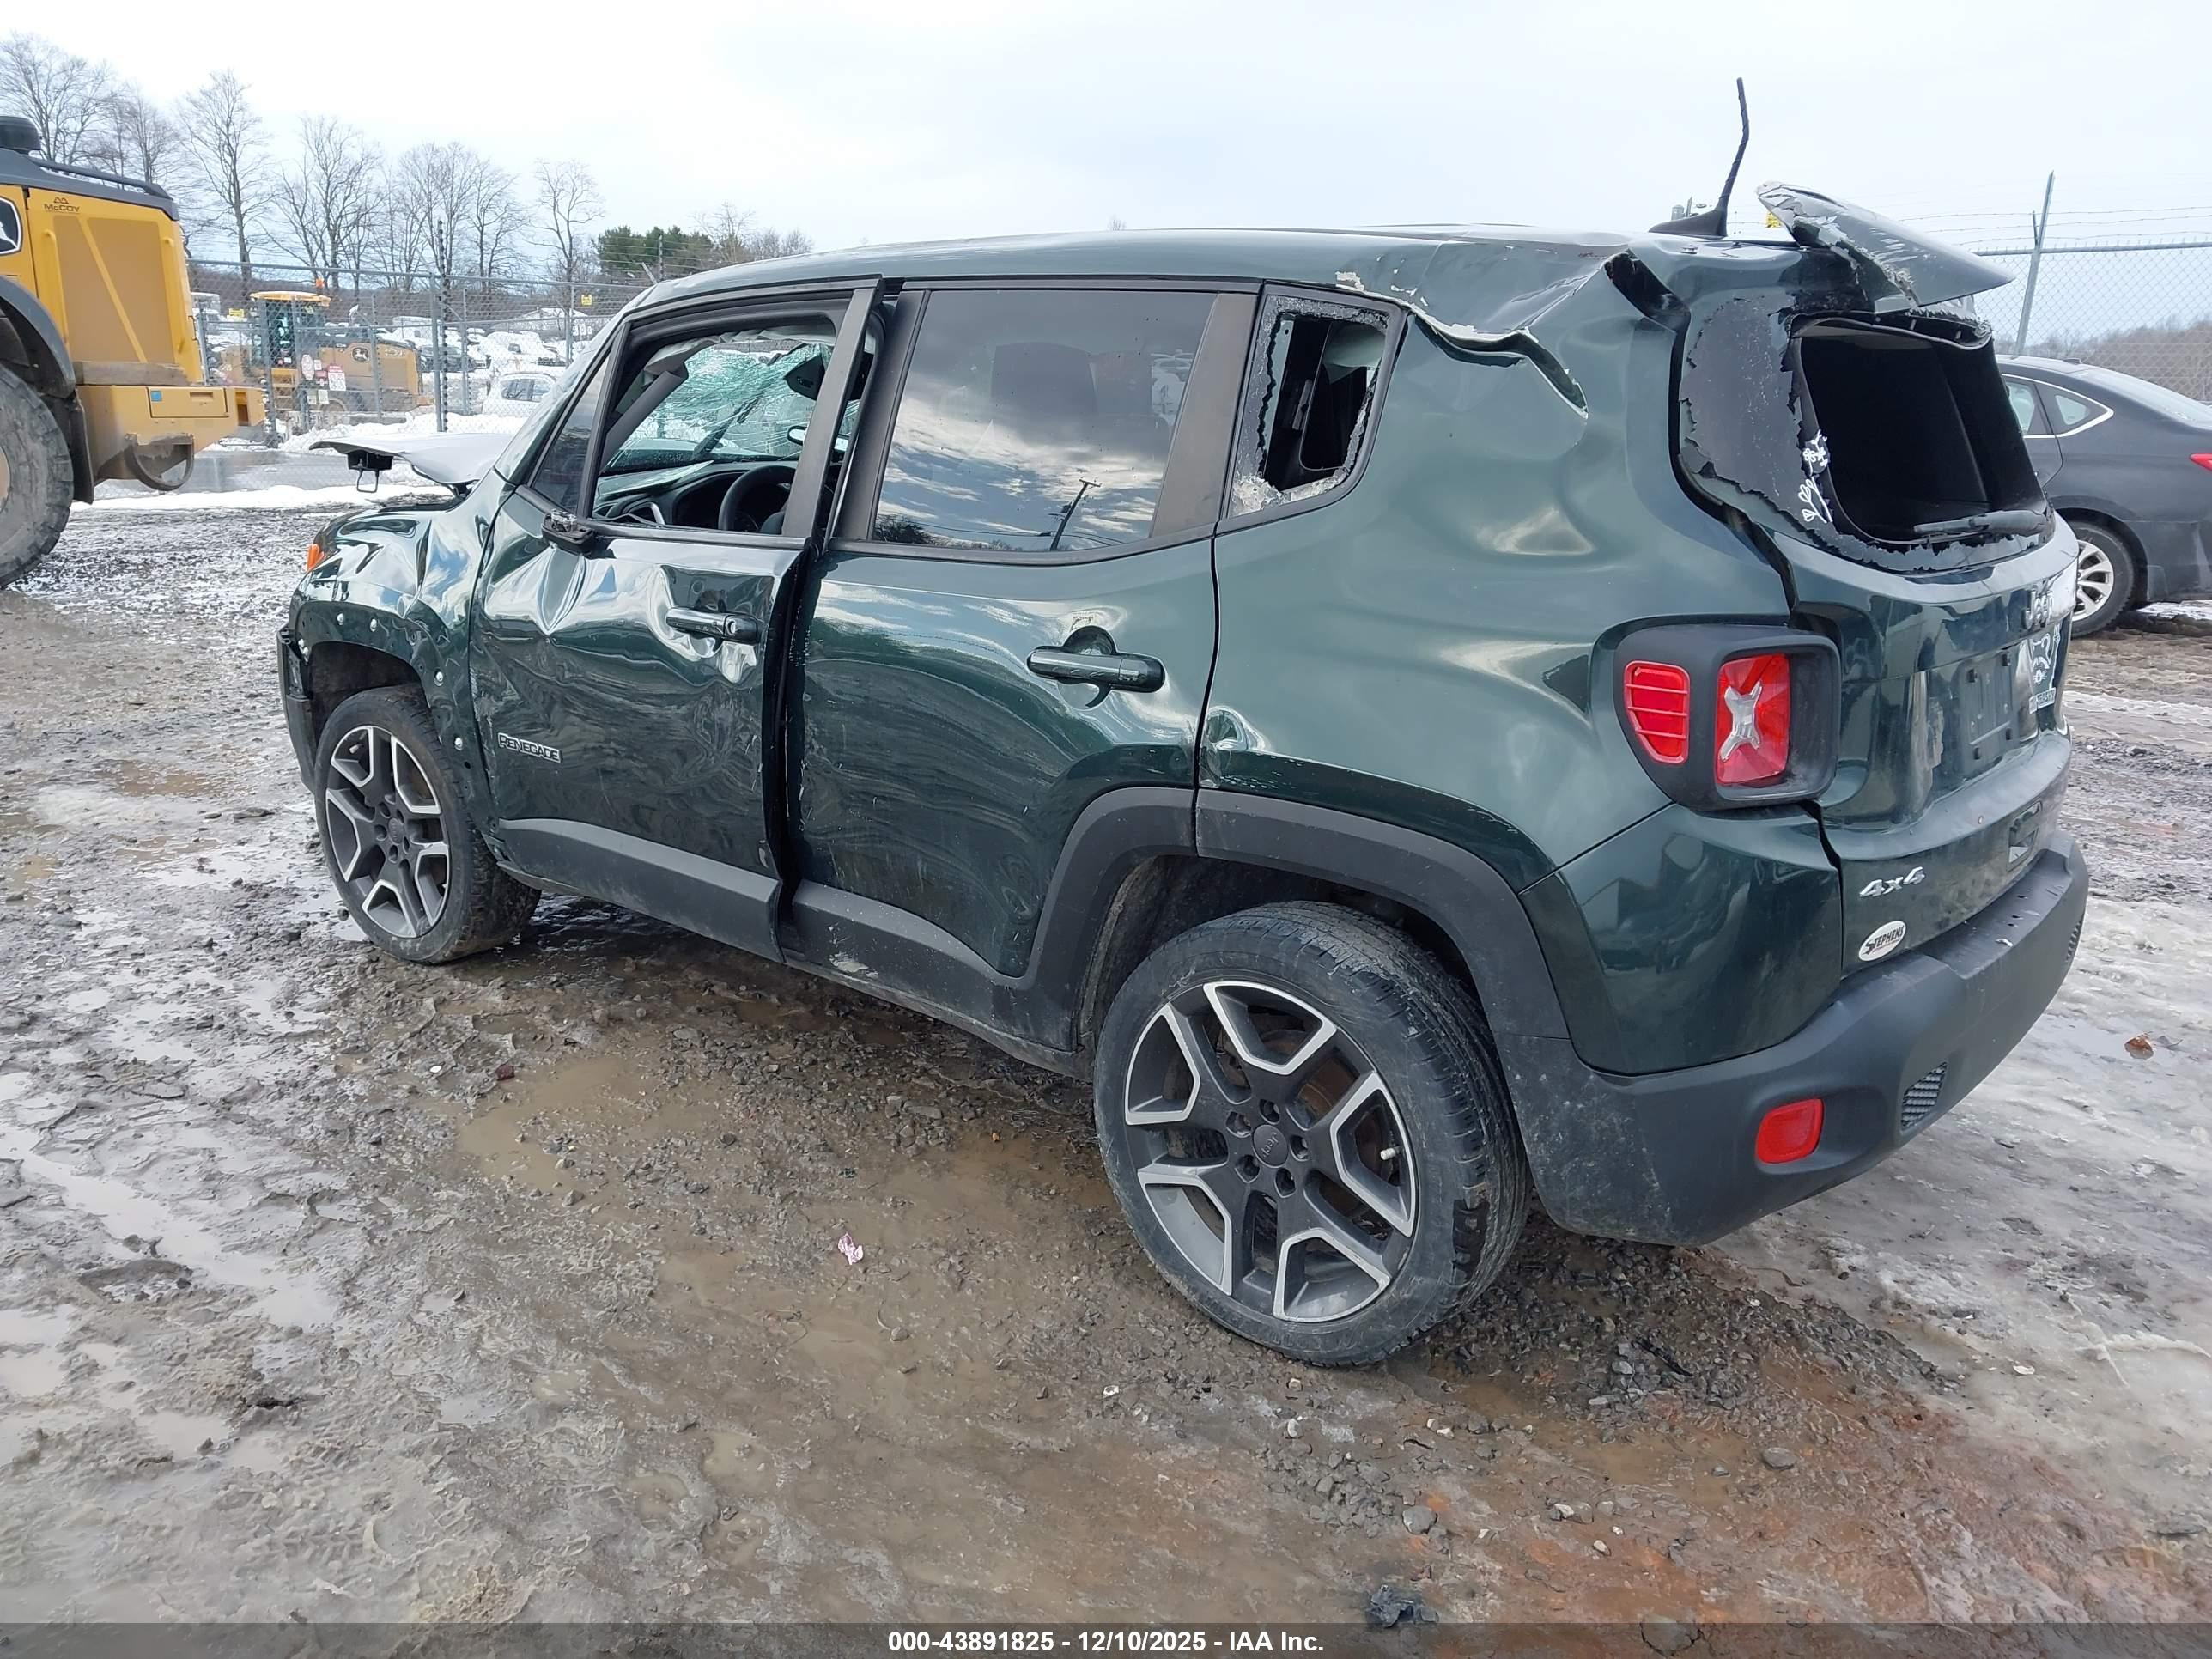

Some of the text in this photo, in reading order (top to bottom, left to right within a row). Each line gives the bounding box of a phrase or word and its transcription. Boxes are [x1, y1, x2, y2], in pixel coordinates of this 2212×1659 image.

[2025, 590, 2054, 629] Jeep
[498, 732, 562, 763] RENEGADE
[1859, 866, 1925, 897] 4x4
[1862, 926, 1905, 955] STEPHENS
[1261, 1132, 1279, 1158] Jeep
